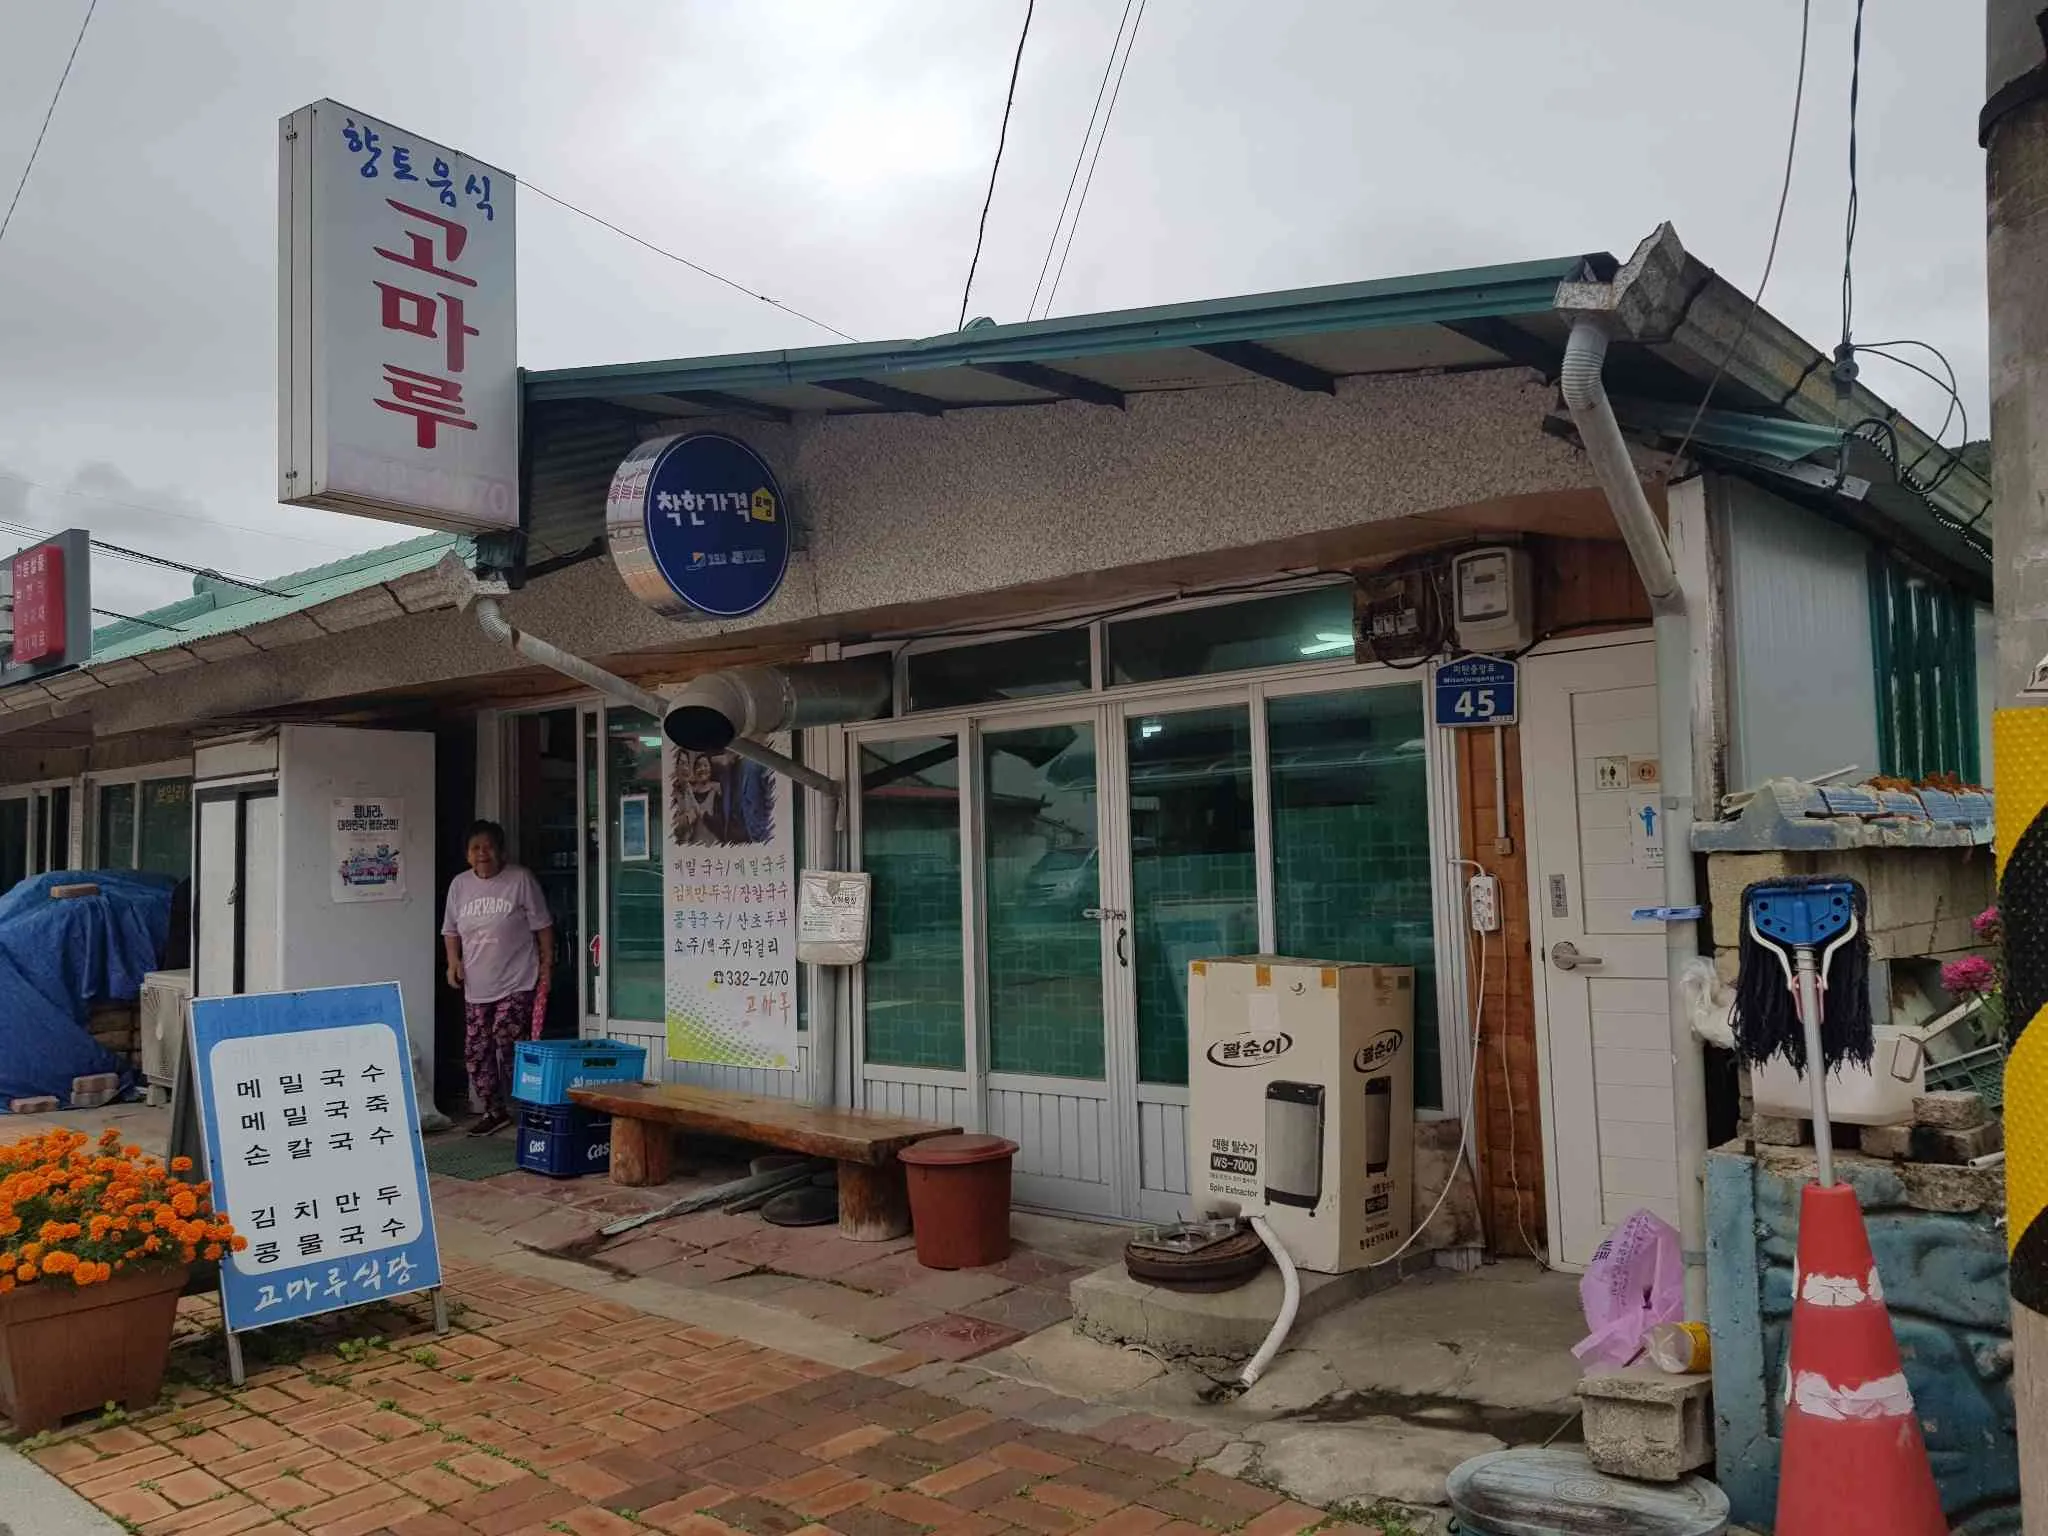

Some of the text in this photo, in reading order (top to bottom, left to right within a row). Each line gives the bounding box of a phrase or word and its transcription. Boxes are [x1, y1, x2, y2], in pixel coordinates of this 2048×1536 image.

[342, 117, 494, 221] 향토음식
[371, 197, 480, 449] 고마루
[656, 489, 751, 527] 착한가격
[1454, 689, 1496, 718] 45
[236, 1063, 386, 1100] 메밀국수
[243, 1125, 395, 1167] 손칼국수
[1212, 1155, 1255, 1174] WS-7000
[249, 1184, 402, 1231] 김치만두
[1209, 1182, 1258, 1198] Spin Extractor
